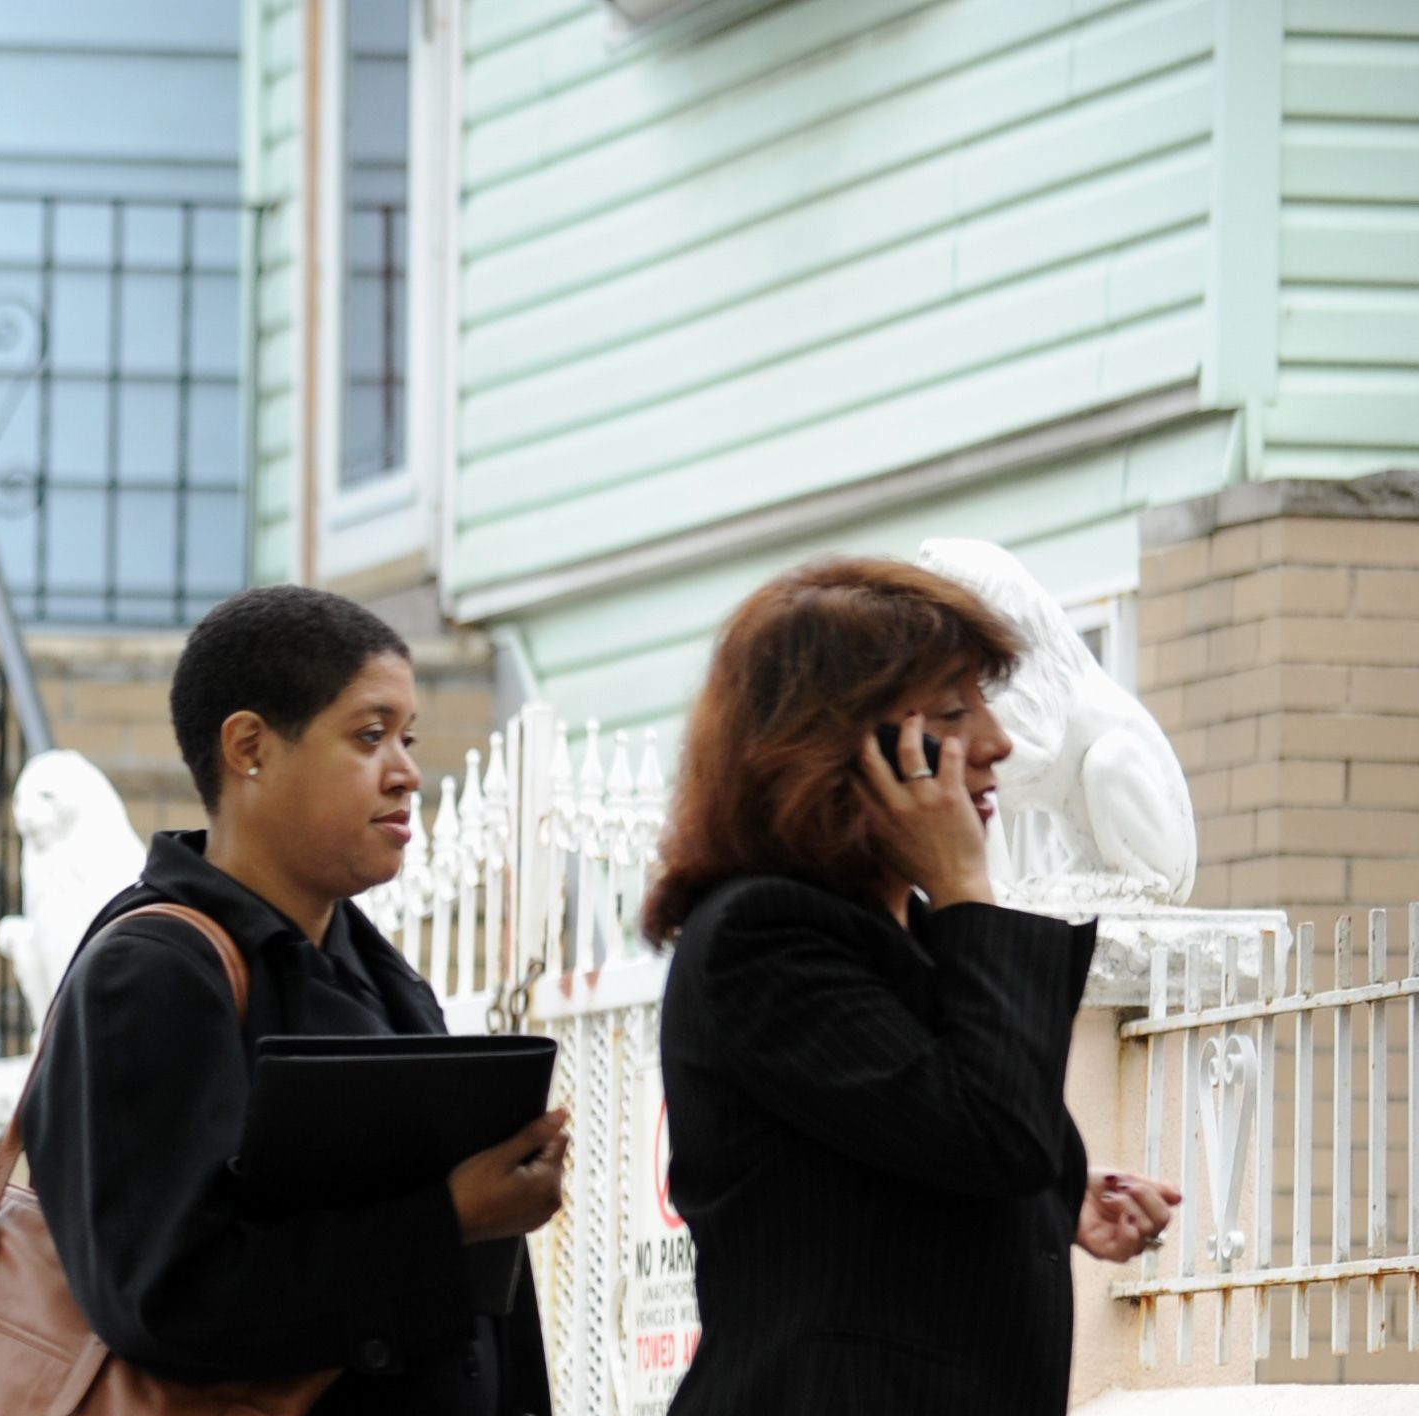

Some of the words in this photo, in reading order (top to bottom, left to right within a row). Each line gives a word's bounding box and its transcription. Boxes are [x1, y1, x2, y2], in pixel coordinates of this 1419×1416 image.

[636, 1241, 652, 1278] NO
[661, 1234, 696, 1275] PARK
[636, 1332, 675, 1373] TOWED
[683, 1329, 702, 1366] AW
[663, 1373, 683, 1394] VEH
